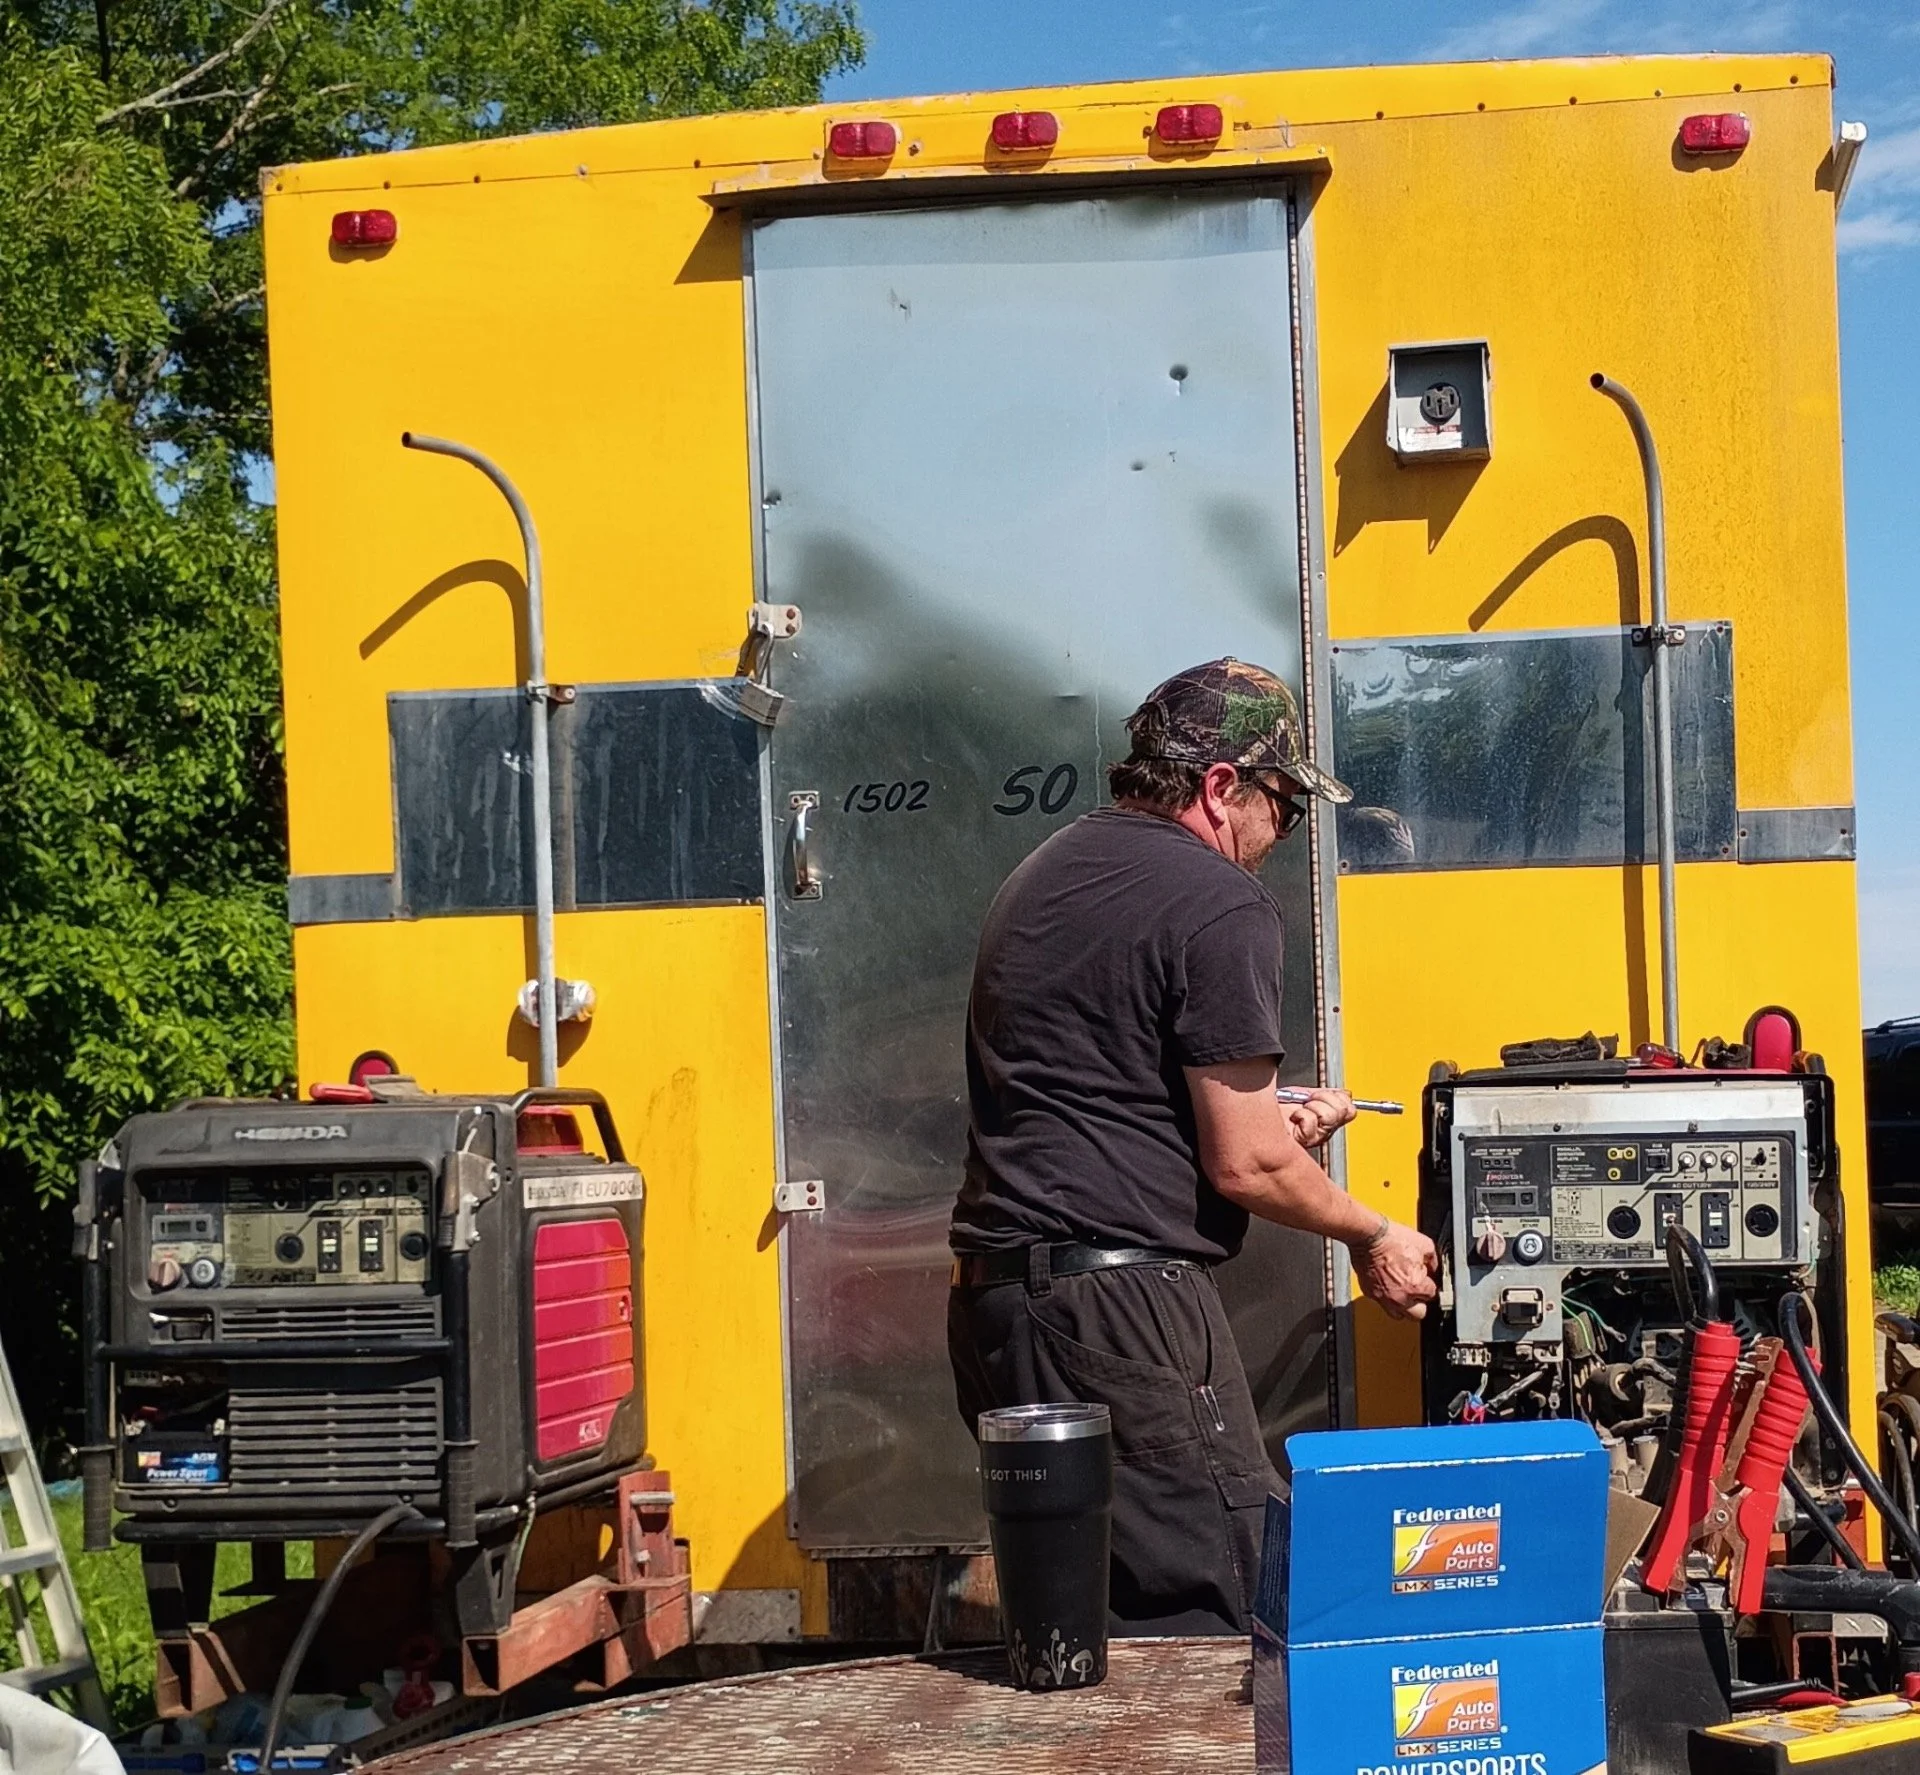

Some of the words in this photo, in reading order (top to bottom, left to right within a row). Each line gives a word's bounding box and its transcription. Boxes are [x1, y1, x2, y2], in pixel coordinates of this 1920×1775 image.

[844, 780, 930, 813] 1502
[990, 1469, 1010, 1480] GOT
[1014, 1468, 1047, 1480] THIS!
[1393, 1503, 1501, 1524] Federated
[1452, 1540, 1494, 1556] Auto
[1445, 1556, 1493, 1571] Parts
[1394, 1581, 1431, 1592] LMX
[1434, 1575, 1499, 1590] SERIES
[1392, 1659, 1499, 1683] Federated
[1453, 1701, 1495, 1717] Auto
[1447, 1716, 1495, 1732] Parts
[1397, 1744, 1434, 1756] LMX
[1437, 1737, 1501, 1754] SERIES
[1357, 1753, 1548, 1775] ERSPORTS
